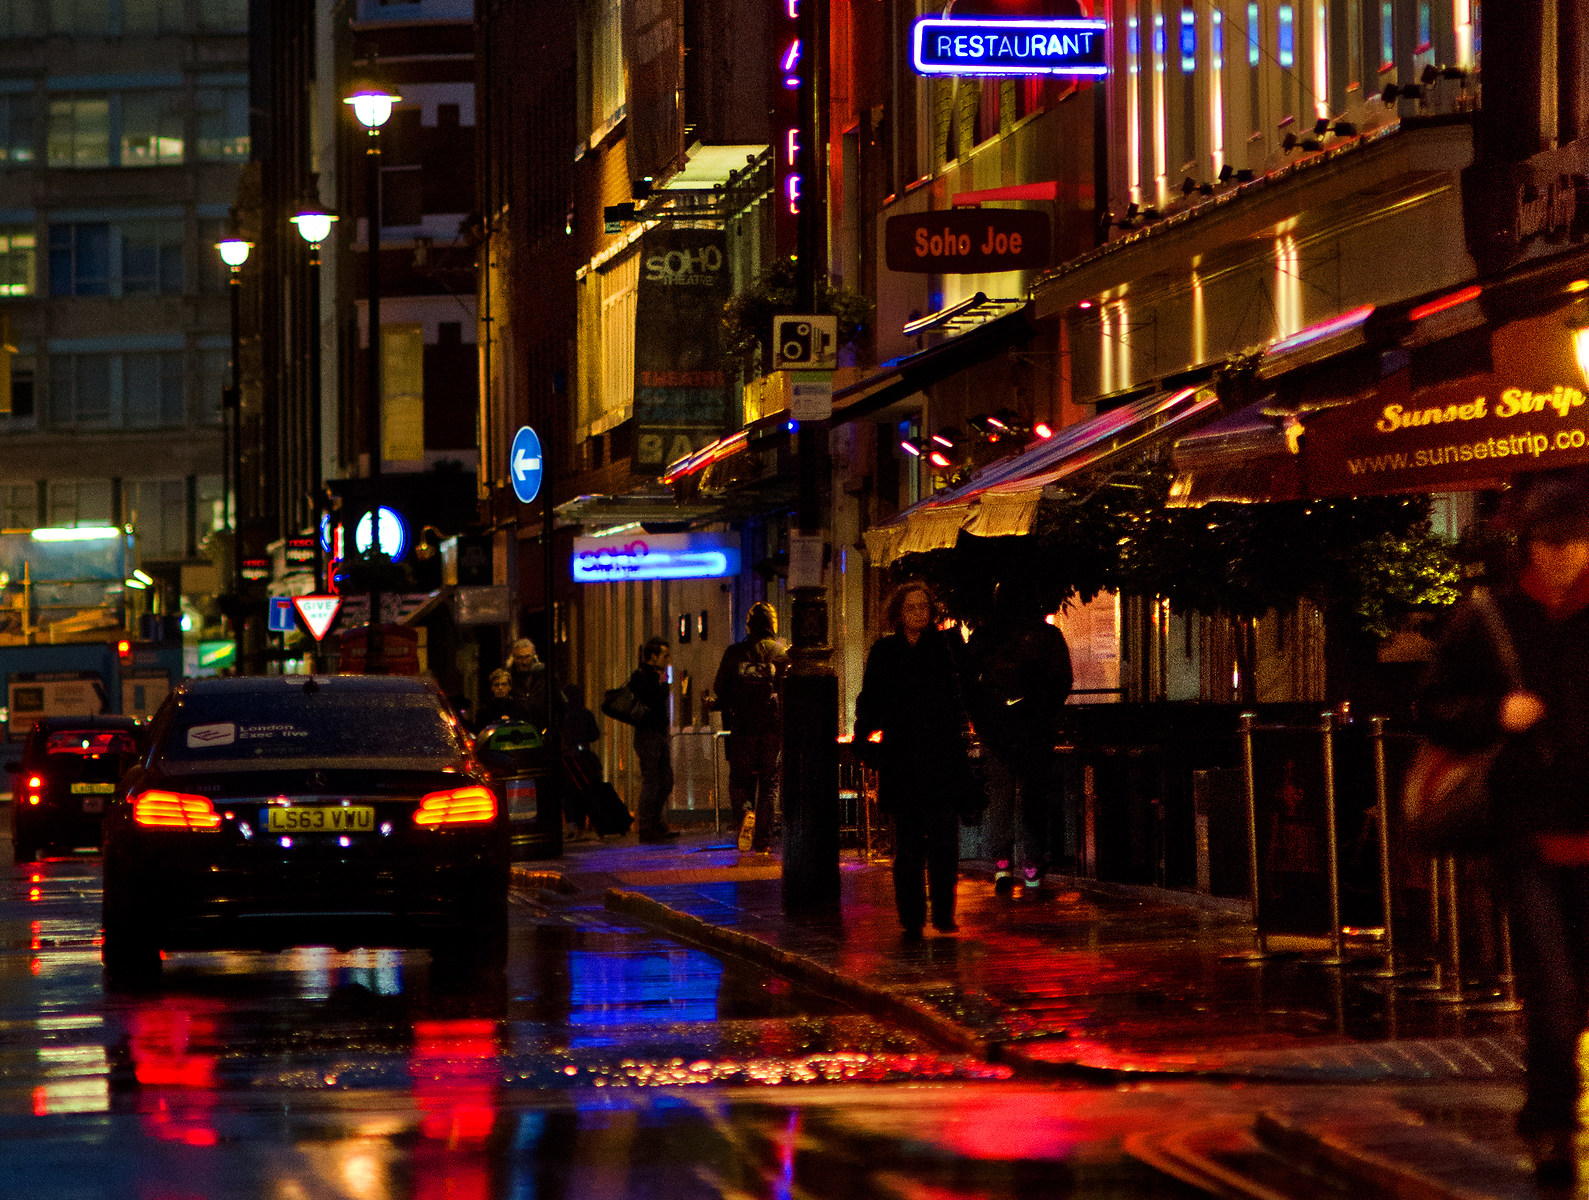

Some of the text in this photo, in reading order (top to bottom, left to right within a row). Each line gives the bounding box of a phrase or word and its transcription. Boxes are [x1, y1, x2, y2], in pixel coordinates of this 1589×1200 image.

[937, 31, 1094, 59] RESTAURANT
[914, 225, 1023, 258] Soho Joe
[646, 244, 722, 280] SOHO
[1374, 385, 1587, 433] Sunset Strip
[303, 601, 332, 611] GIVE
[240, 724, 294, 734] London
[240, 730, 308, 740] Exective
[272, 809, 371, 829] LS63 VWU
